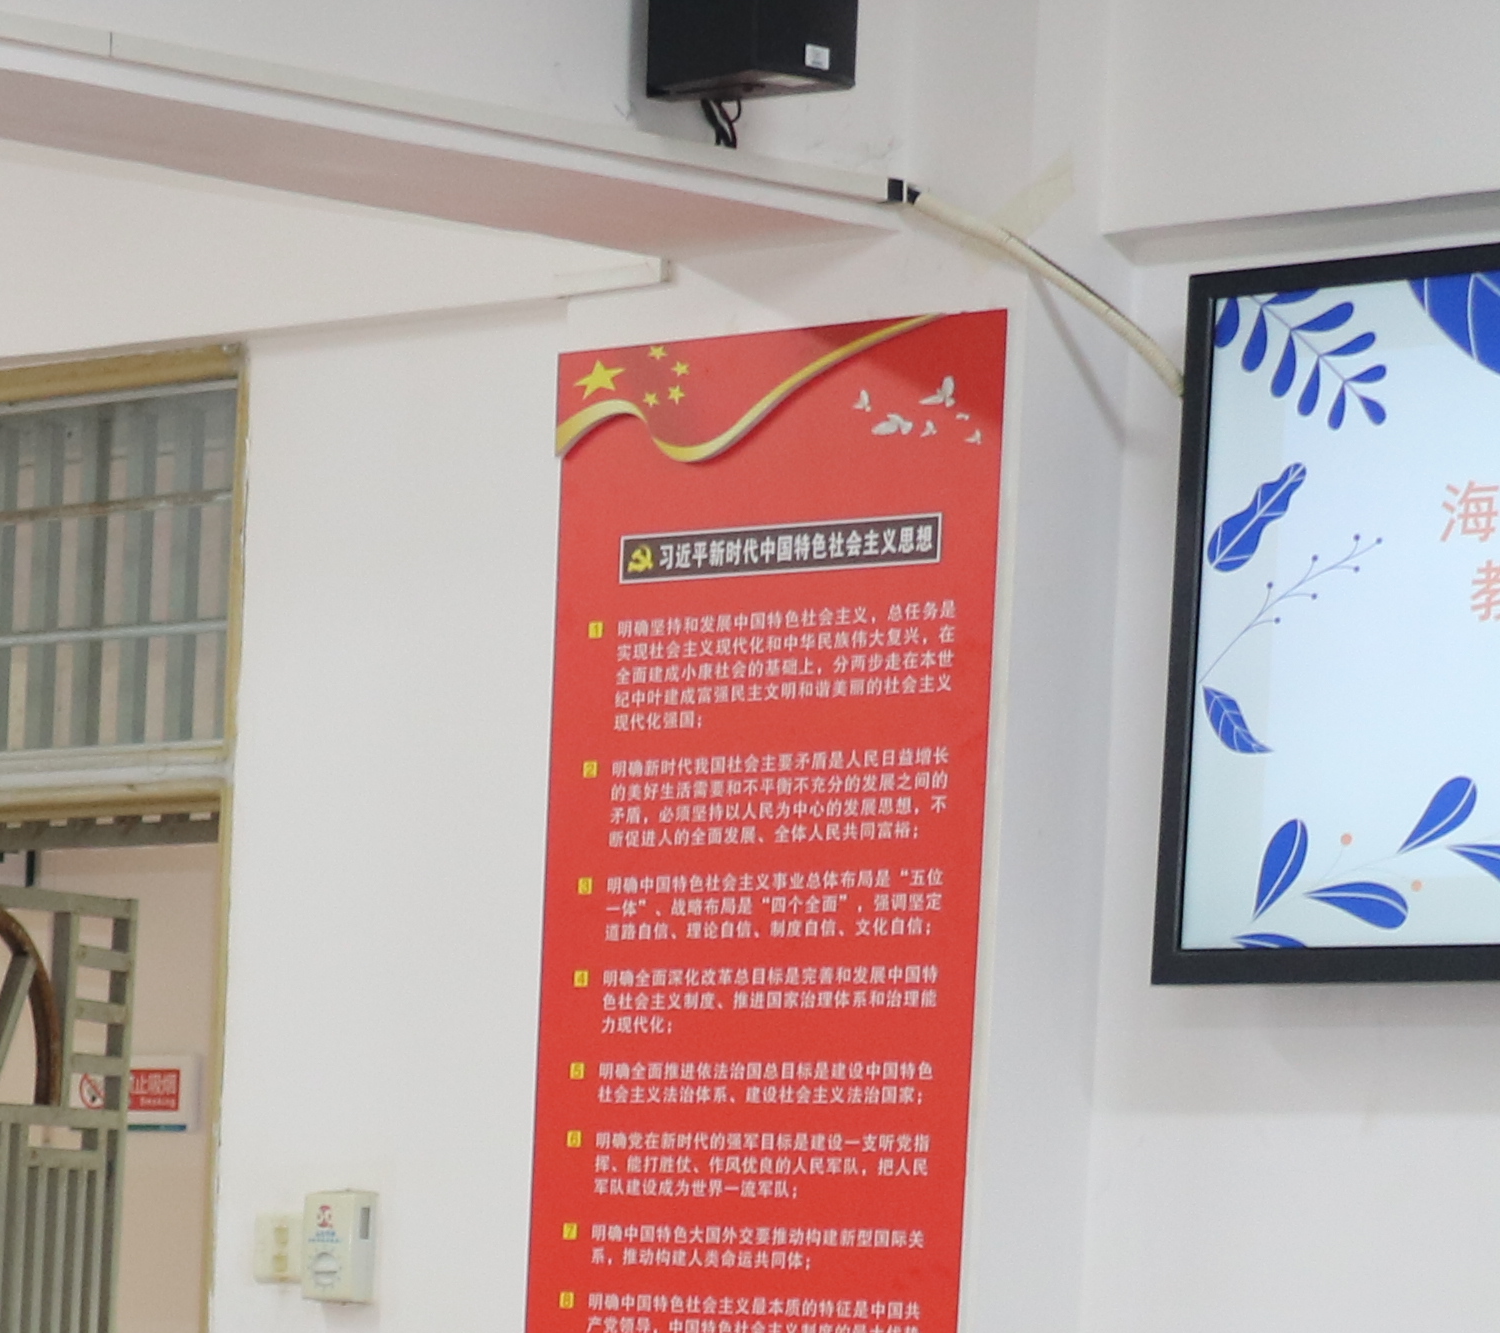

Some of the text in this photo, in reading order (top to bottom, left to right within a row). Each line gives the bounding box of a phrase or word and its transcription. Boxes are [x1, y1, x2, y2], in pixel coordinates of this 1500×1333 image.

[1440, 480, 1499, 542] 海
[659, 524, 933, 571] 习近平新时代中国特色社会主义思想
